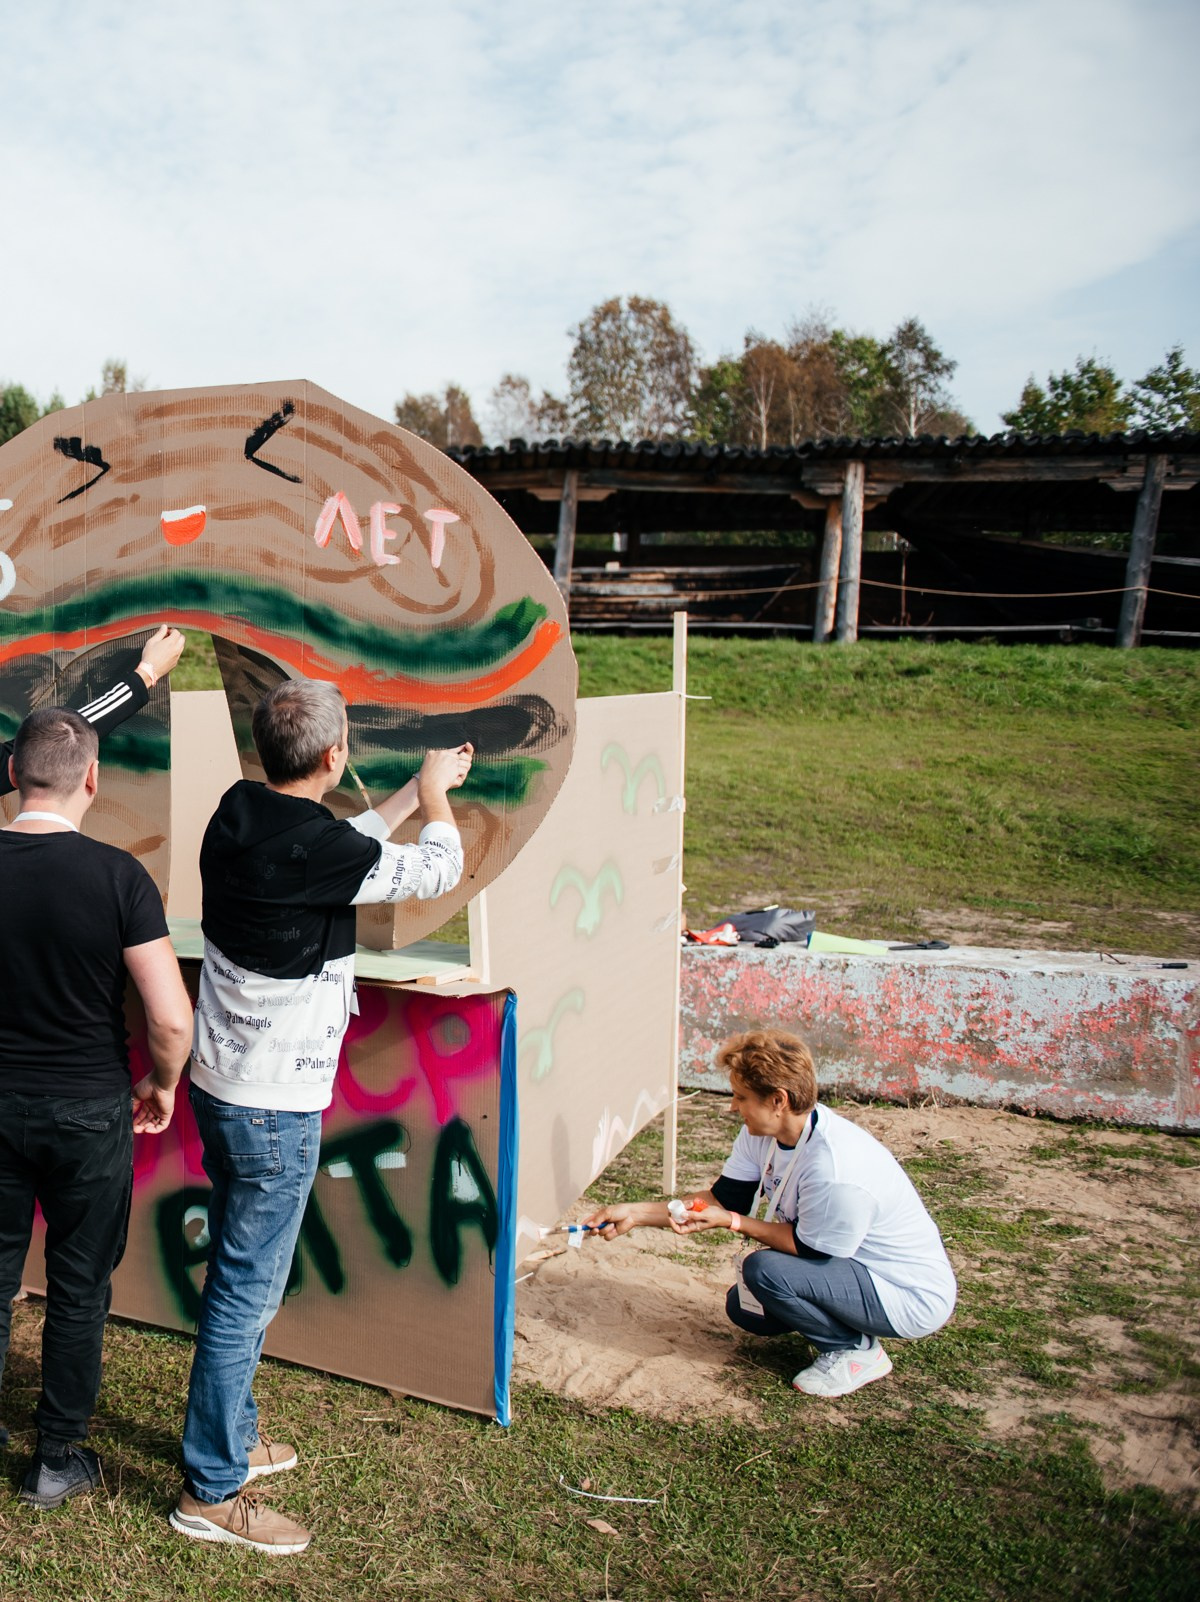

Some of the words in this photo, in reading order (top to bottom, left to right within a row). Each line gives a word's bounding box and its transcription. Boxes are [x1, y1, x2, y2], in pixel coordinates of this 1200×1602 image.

[314, 490, 461, 568] ЛЕТ
[245, 1015, 272, 1030] Angels
[224, 1038, 248, 1055] Angels
